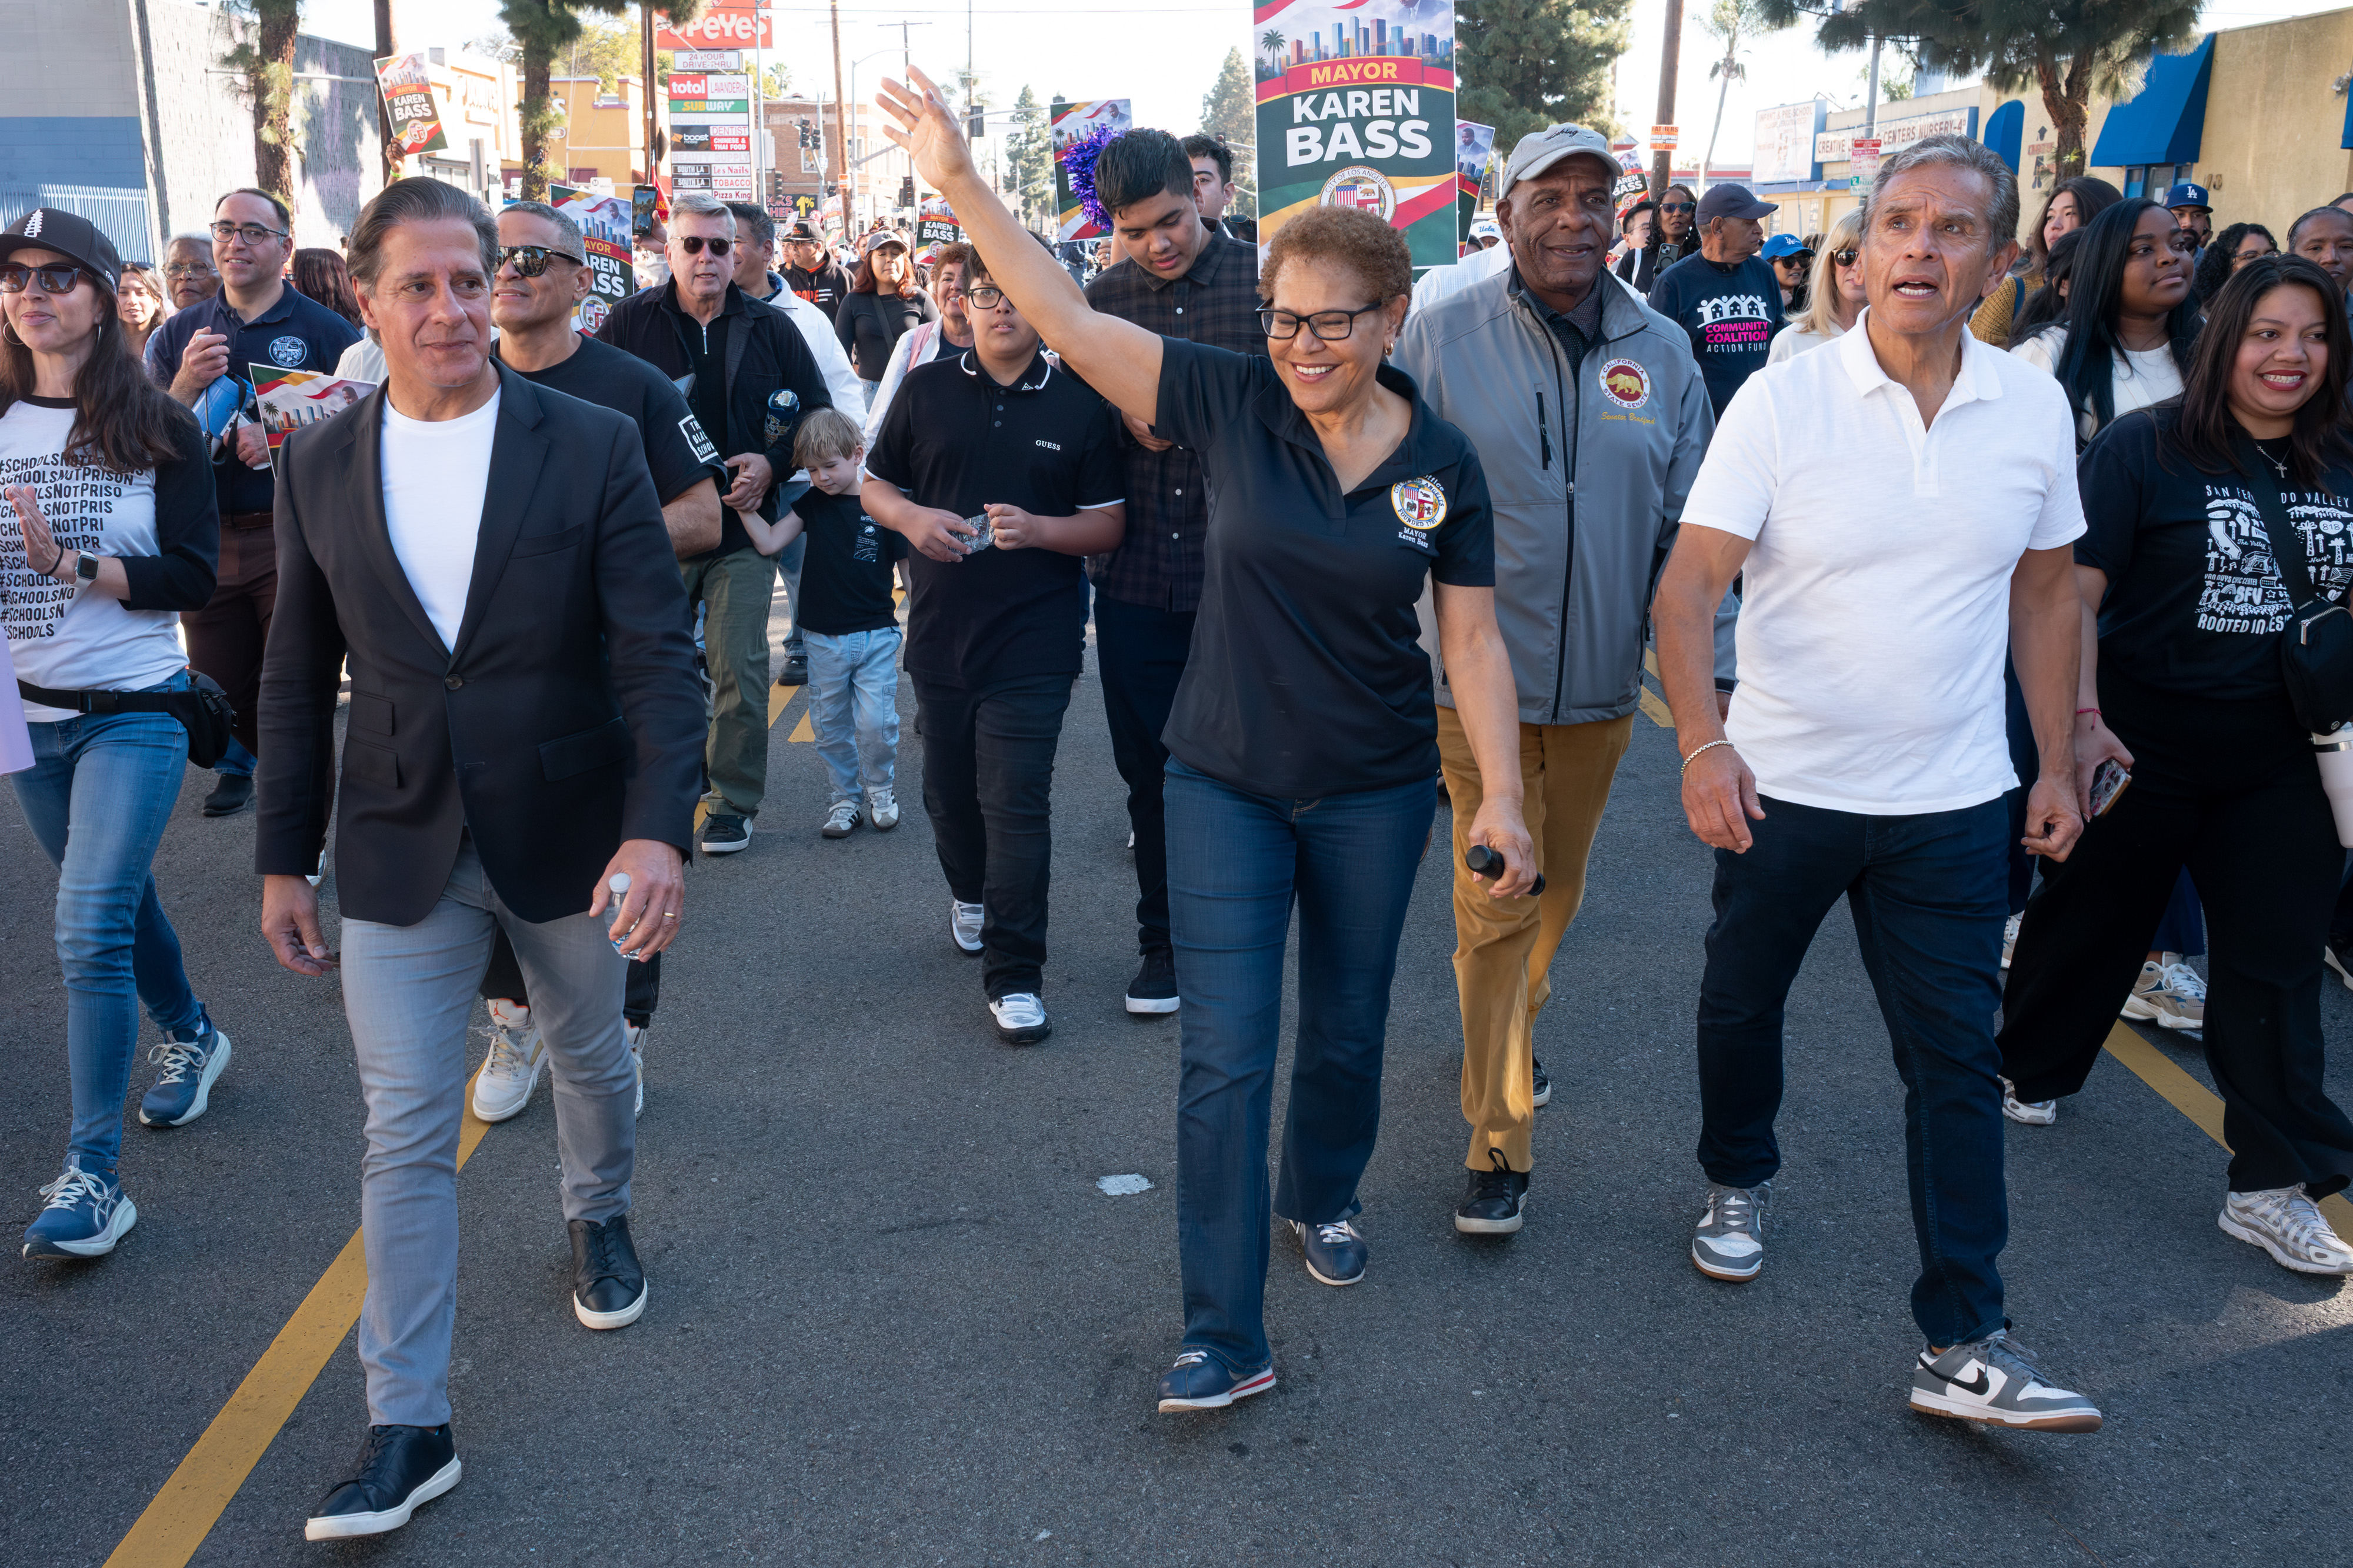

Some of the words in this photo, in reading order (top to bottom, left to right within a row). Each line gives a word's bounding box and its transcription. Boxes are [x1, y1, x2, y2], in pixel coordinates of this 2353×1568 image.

[1311, 62, 1398, 85] MAYOR
[396, 85, 417, 94] MAYOR
[672, 79, 705, 94] total
[711, 82, 746, 94] LAVANDERIA
[394, 94, 425, 107] KAREN
[682, 101, 734, 111] SUBWAY
[1294, 89, 1419, 124] KAREN
[394, 103, 432, 122] BASS
[1287, 119, 1432, 167] BASS
[1818, 139, 1845, 154] CREATIVE
[1884, 126, 1915, 145] CENTERS
[674, 154, 709, 162] BEAUTY
[1325, 177, 1338, 194] CITY
[1362, 169, 1388, 189] ANGELES
[1617, 174, 1639, 185] AREN
[735, 191, 751, 200] King
[2187, 186, 2198, 199] LA
[826, 221, 842, 231] BASS
[925, 221, 953, 232] KAREN
[922, 228, 954, 242] BASS
[585, 241, 611, 254] AYOR
[1706, 322, 1768, 333] COMMUNITY
[1706, 331, 1768, 343] COALITION
[1707, 343, 1743, 353] ACTION
[1748, 342, 1767, 352] FUND
[1603, 359, 1644, 375] CALIFORNIA
[1604, 388, 1624, 405] STATE
[1627, 392, 1648, 408] SENATE
[1601, 412, 1627, 421] Senator
[1629, 412, 1655, 425] Bradford
[1035, 440, 1061, 451] GUESS
[1425, 482, 1444, 506] ANGELES
[2206, 485, 2229, 497] SAN
[2305, 492, 2349, 508] VALLEY
[1398, 508, 1424, 527] FOUNDED
[1398, 532, 1415, 543] Karen
[1417, 538, 1428, 548] Bass
[1404, 527, 1427, 540] MAYOR
[2250, 540, 2267, 551] Valley
[2217, 575, 2232, 583] NUYS
[1, 588, 75, 605] #SCHOOLSNO
[2234, 586, 2263, 605] SFV
[1, 603, 64, 623] #SCHOOLSN
[2198, 613, 2249, 633] ROOTED
[2251, 619, 2266, 635] IN
